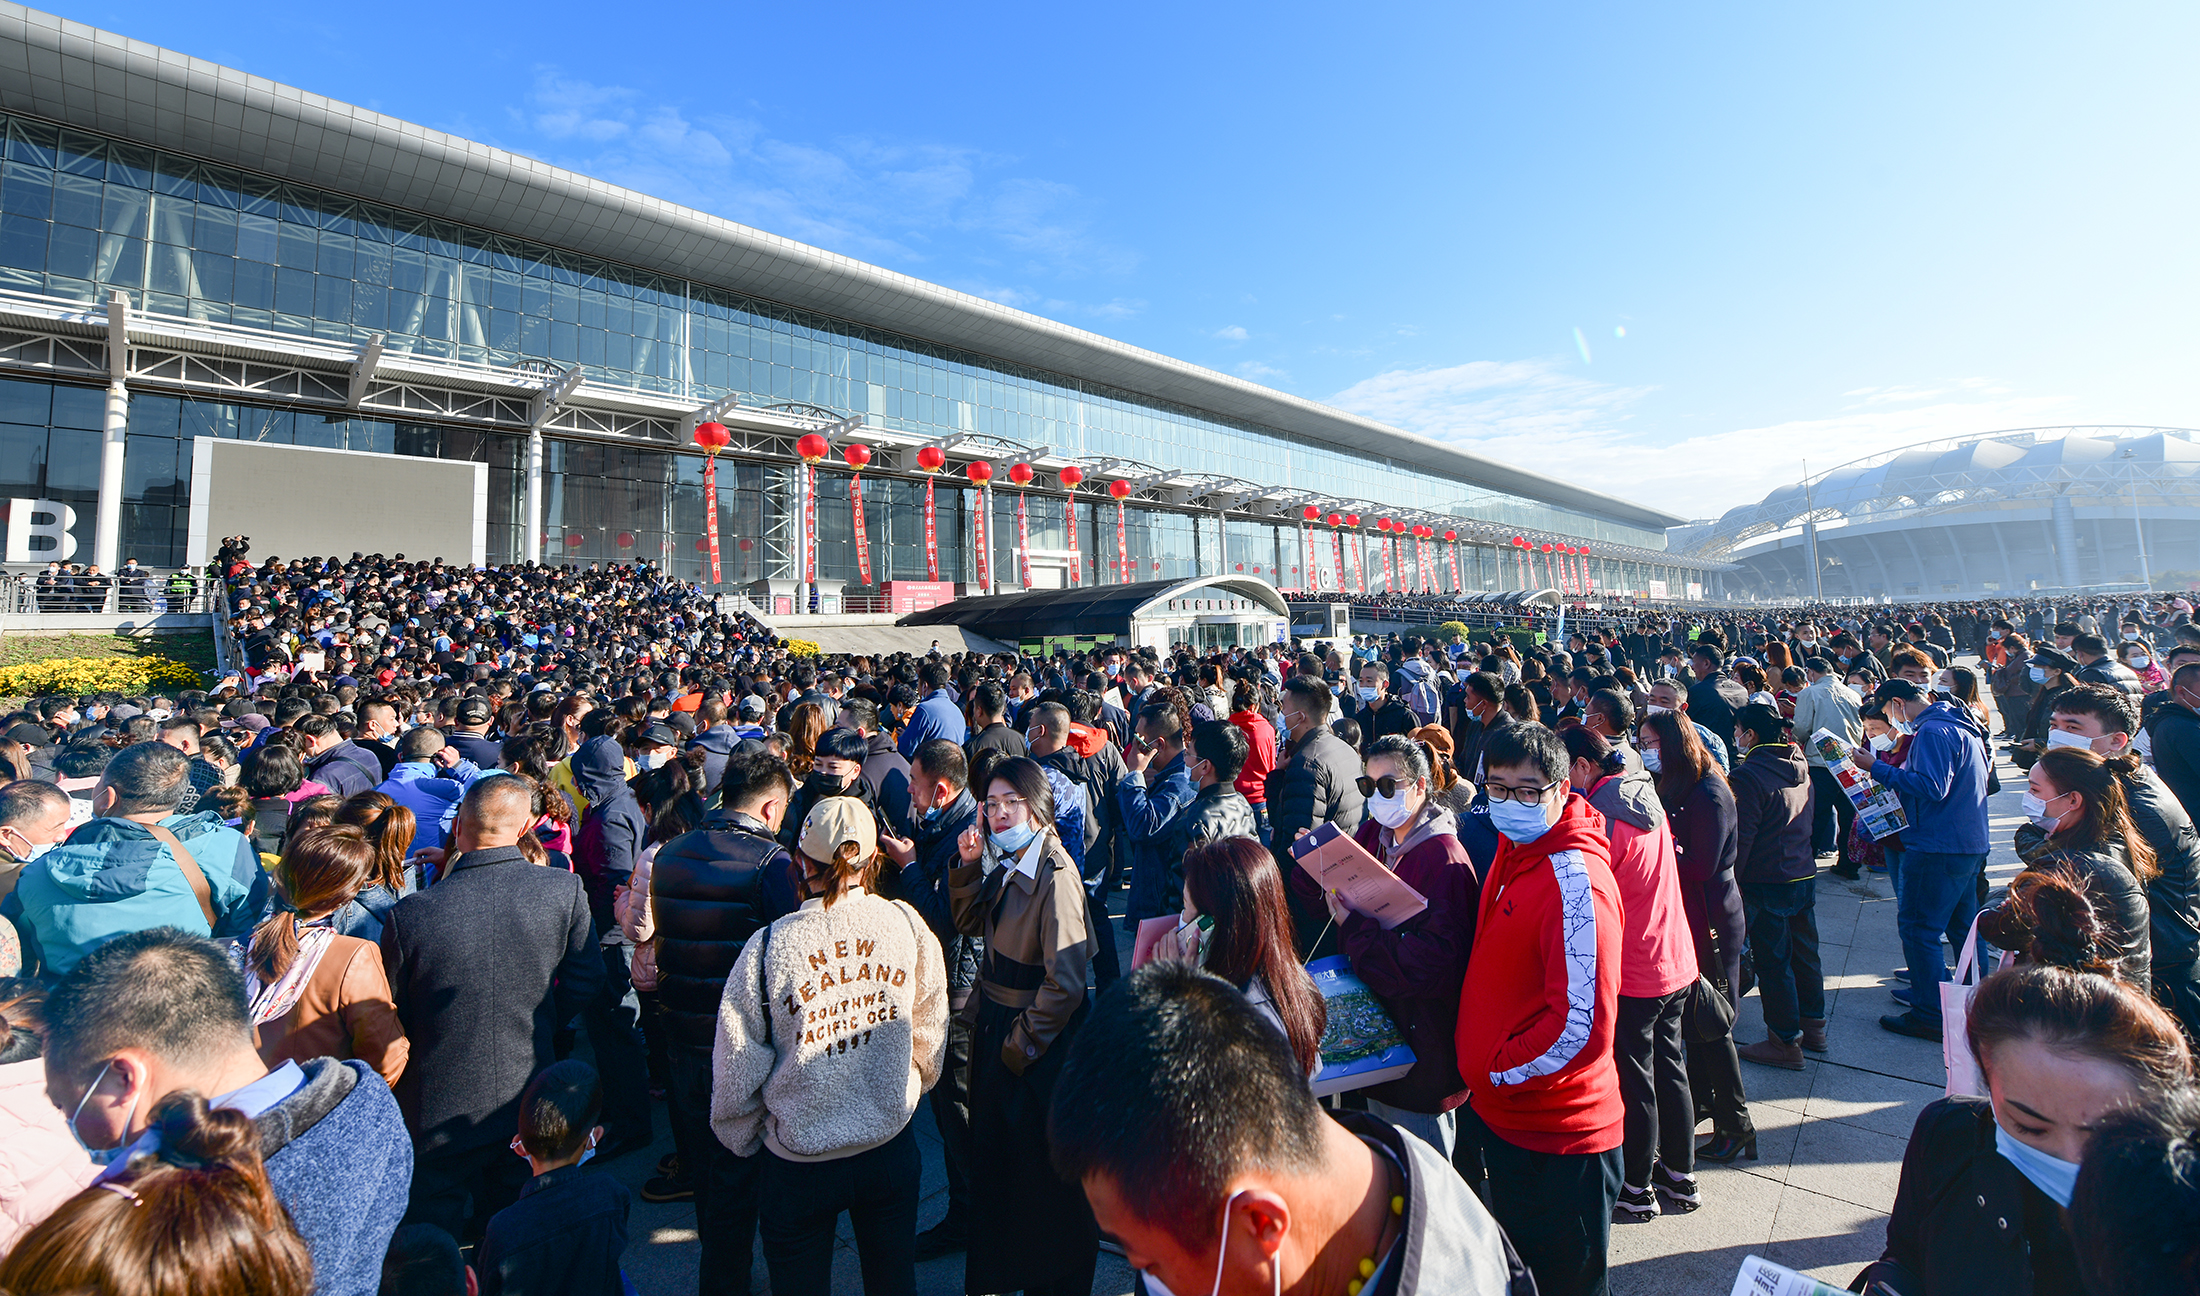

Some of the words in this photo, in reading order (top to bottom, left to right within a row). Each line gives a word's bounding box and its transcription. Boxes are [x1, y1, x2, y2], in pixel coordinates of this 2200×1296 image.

[6, 498, 78, 563] B
[1320, 567, 1331, 589] C
[808, 939, 875, 971] NEW
[783, 963, 906, 1016] ZEALAND
[808, 991, 886, 1024] SOUTHWE
[867, 1005, 897, 1025] OCE
[825, 1030, 872, 1058] 1997
